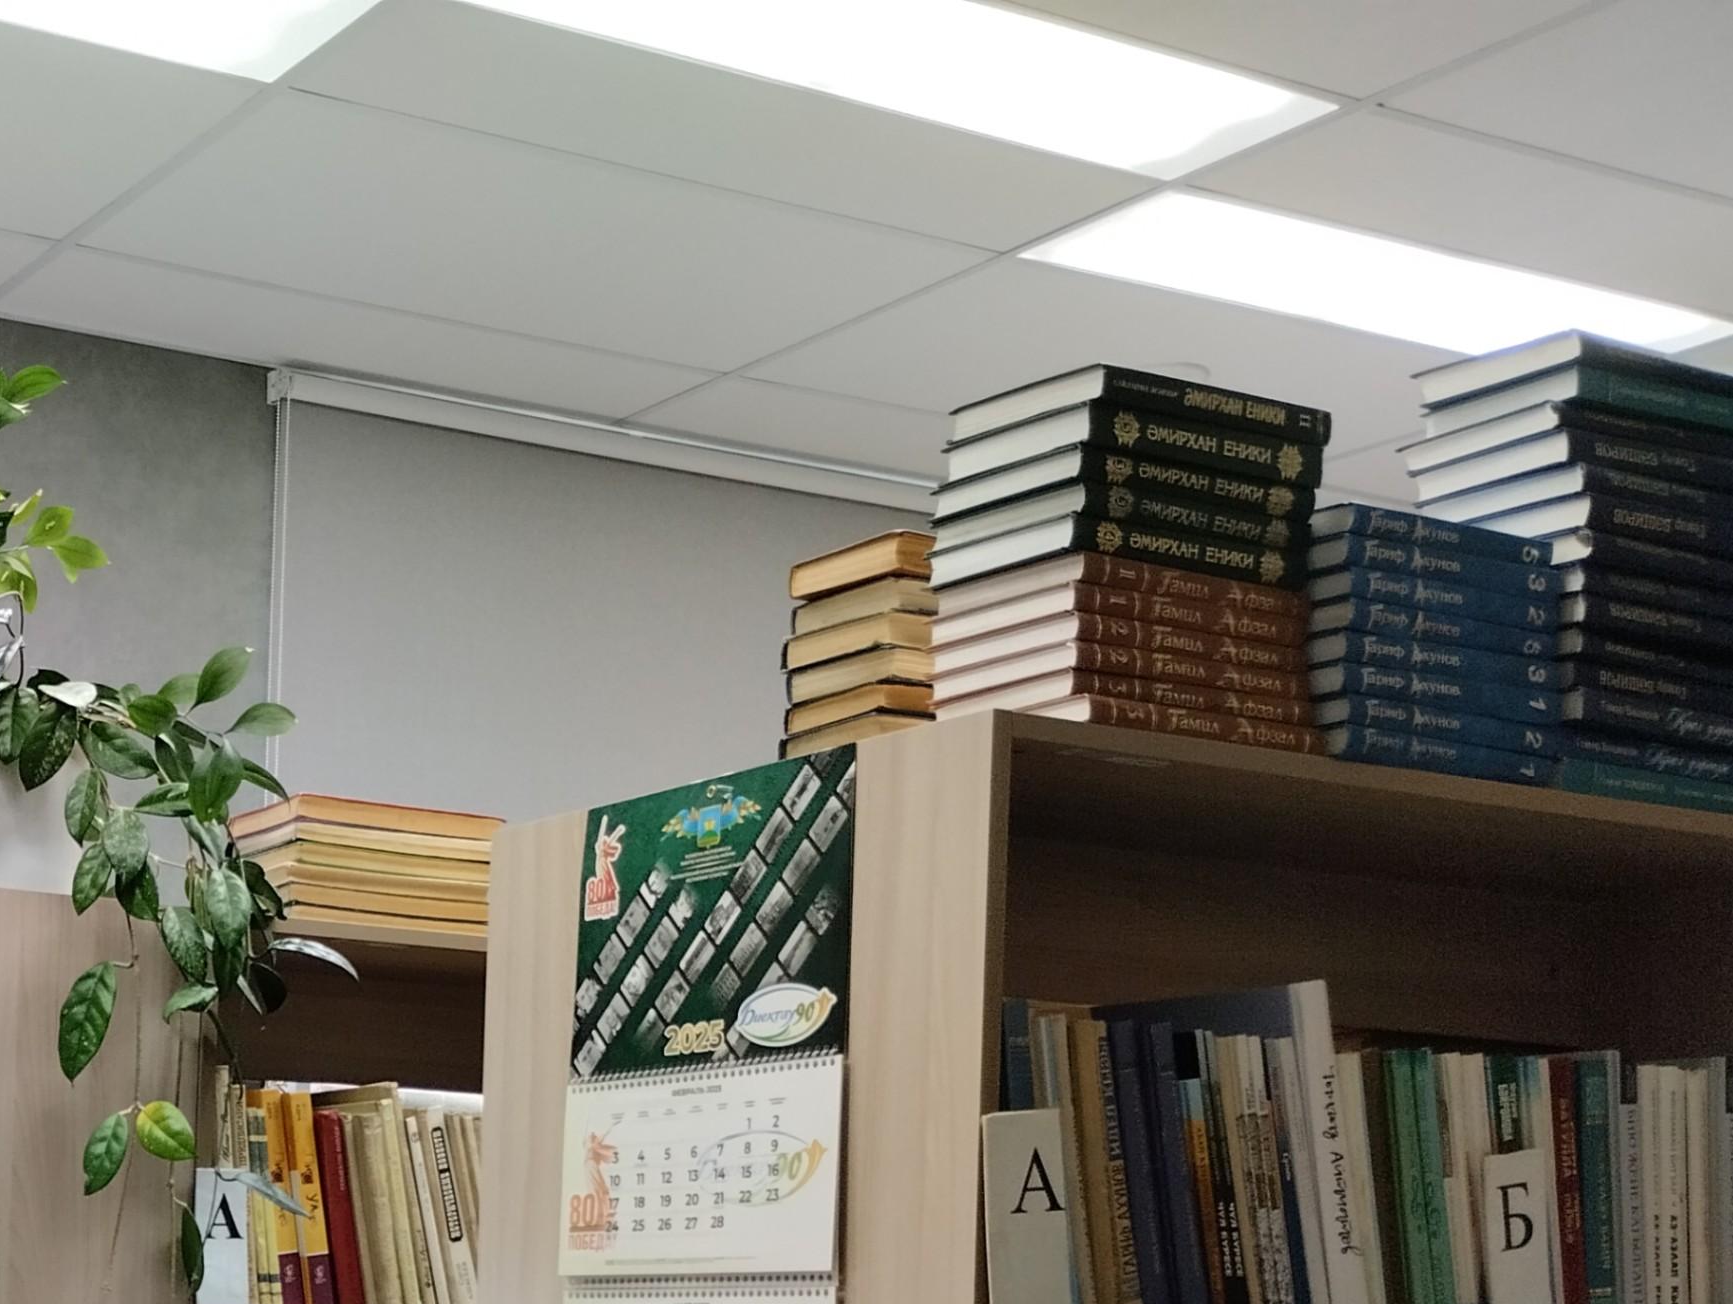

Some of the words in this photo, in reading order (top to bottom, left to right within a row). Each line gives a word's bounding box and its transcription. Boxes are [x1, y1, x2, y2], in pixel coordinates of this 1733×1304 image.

[1147, 425, 1217, 452] ӘМИРХАН
[1223, 441, 1271, 464] ЕНИКИ
[1139, 463, 1209, 489] ӘМИРХАН
[1215, 480, 1264, 502] ЕНИКИ
[1140, 500, 1208, 526] ӘМИРХАН
[1213, 516, 1262, 539] ЕНИКИ
[1130, 533, 1198, 559] ӘМИРХАН
[1206, 546, 1254, 570] ЕНИКИ
[796, 1002, 814, 1023] 90
[664, 1022, 725, 1056] 2025
[747, 1118, 751, 1130] 1
[772, 1116, 780, 1128] 2
[612, 1151, 619, 1163] 3
[638, 1150, 644, 1162] 4
[664, 1148, 671, 1160] 5
[690, 1147, 697, 1158] 6
[717, 1144, 724, 1156] 7
[744, 1142, 750, 1154] 8
[771, 1140, 778, 1151] 9
[610, 1175, 621, 1187] 10
[638, 1173, 644, 1185] 11
[662, 1172, 672, 1183] 12
[688, 1170, 699, 1181] 13
[714, 1168, 725, 1180] 14
[741, 1166, 752, 1178] 15
[768, 1164, 779, 1176] 16
[1011, 1147, 1066, 1214] А
[207, 1193, 242, 1240] А
[609, 1198, 619, 1210] 17
[634, 1197, 645, 1208] 18
[660, 1195, 671, 1207] 19
[685, 1194, 699, 1205] 20
[714, 1192, 724, 1204] 21
[739, 1191, 752, 1203] 22
[766, 1189, 779, 1201] 23
[1498, 1182, 1534, 1252] Б
[606, 1221, 619, 1232] 24
[632, 1220, 644, 1231] 25
[658, 1218, 672, 1230] 26
[685, 1218, 698, 1229] 27
[710, 1216, 724, 1228] 28
